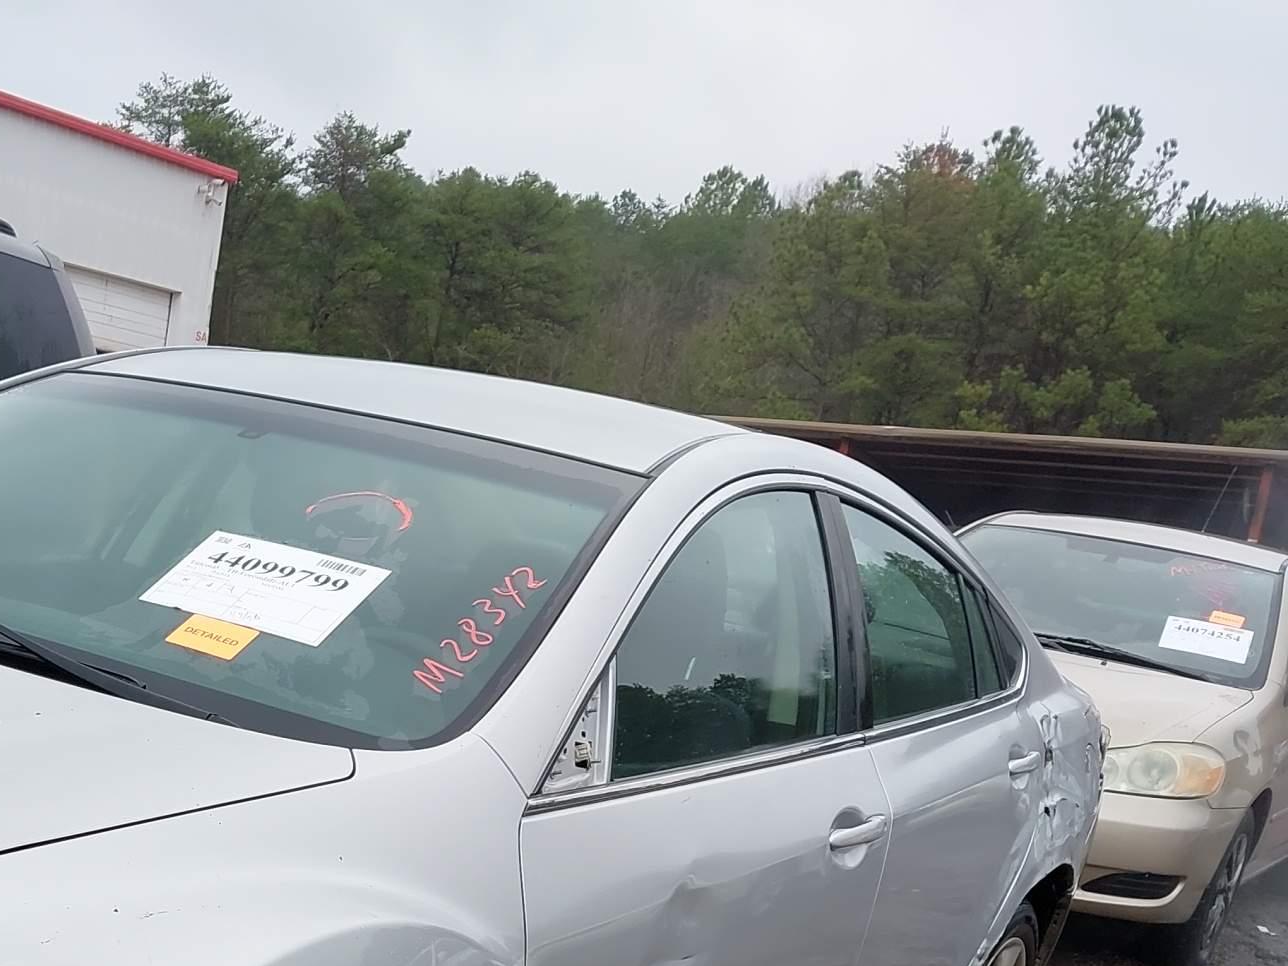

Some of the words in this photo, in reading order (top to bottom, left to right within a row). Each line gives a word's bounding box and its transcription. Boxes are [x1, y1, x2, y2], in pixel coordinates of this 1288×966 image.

[208, 552, 349, 591] 44099799
[184, 626, 239, 646] DETAILED
[1173, 624, 1241, 642] 44074254
